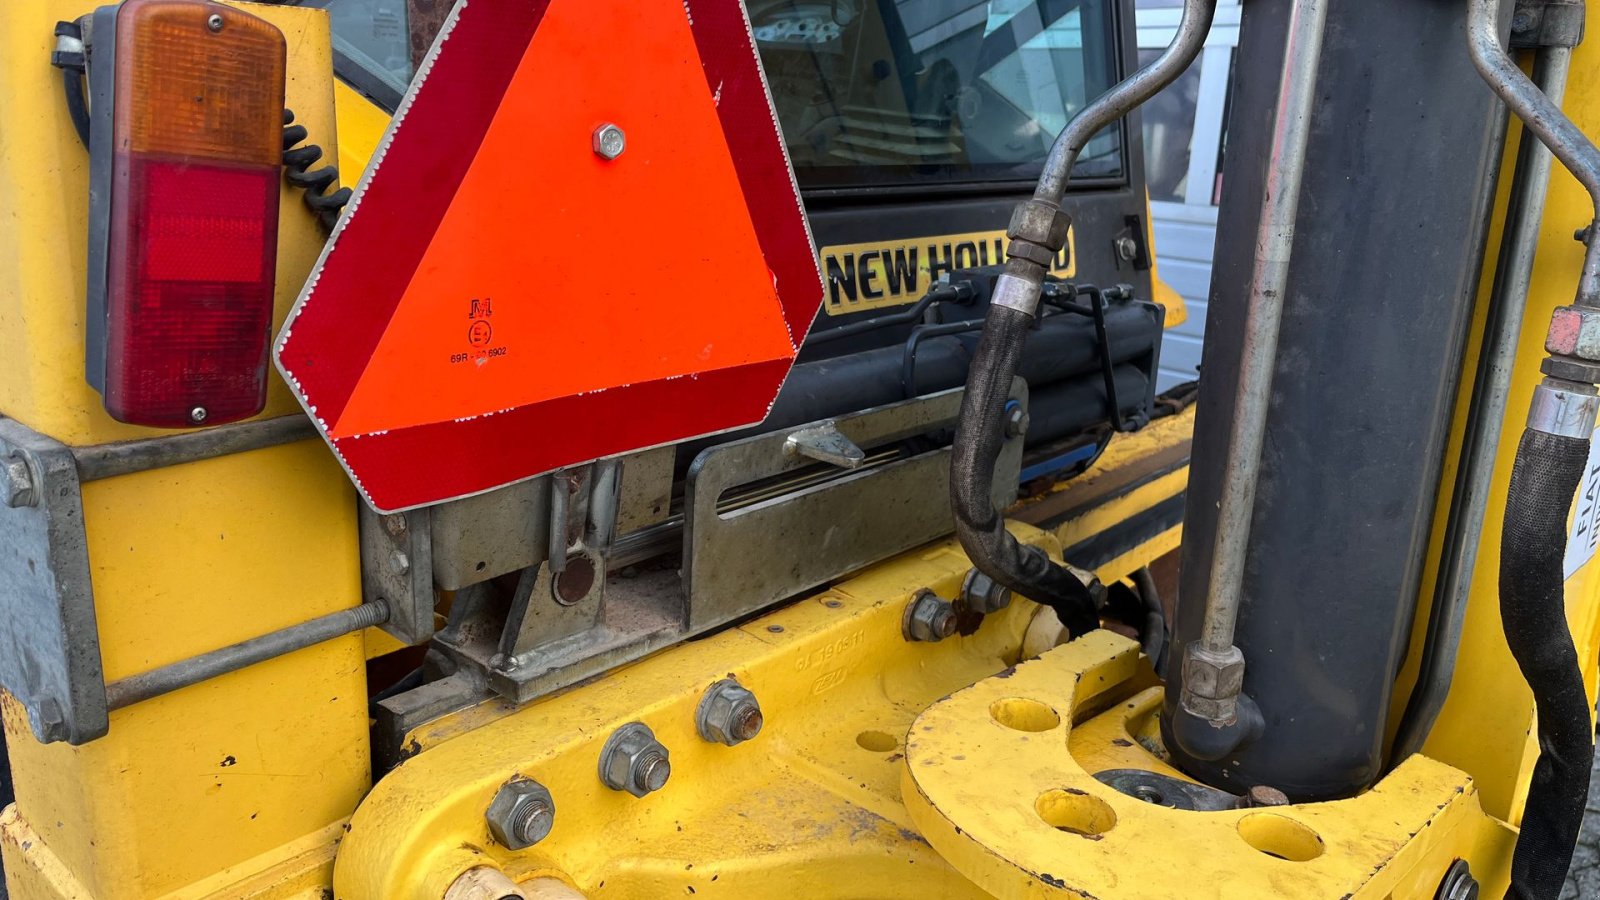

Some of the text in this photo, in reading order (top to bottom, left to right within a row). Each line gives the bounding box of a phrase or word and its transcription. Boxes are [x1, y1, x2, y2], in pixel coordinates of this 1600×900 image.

[826, 247, 918, 306] NEW
[450, 353, 468, 363] 69R
[488, 346, 507, 358] 6902
[1577, 465, 1600, 536] FIAT
